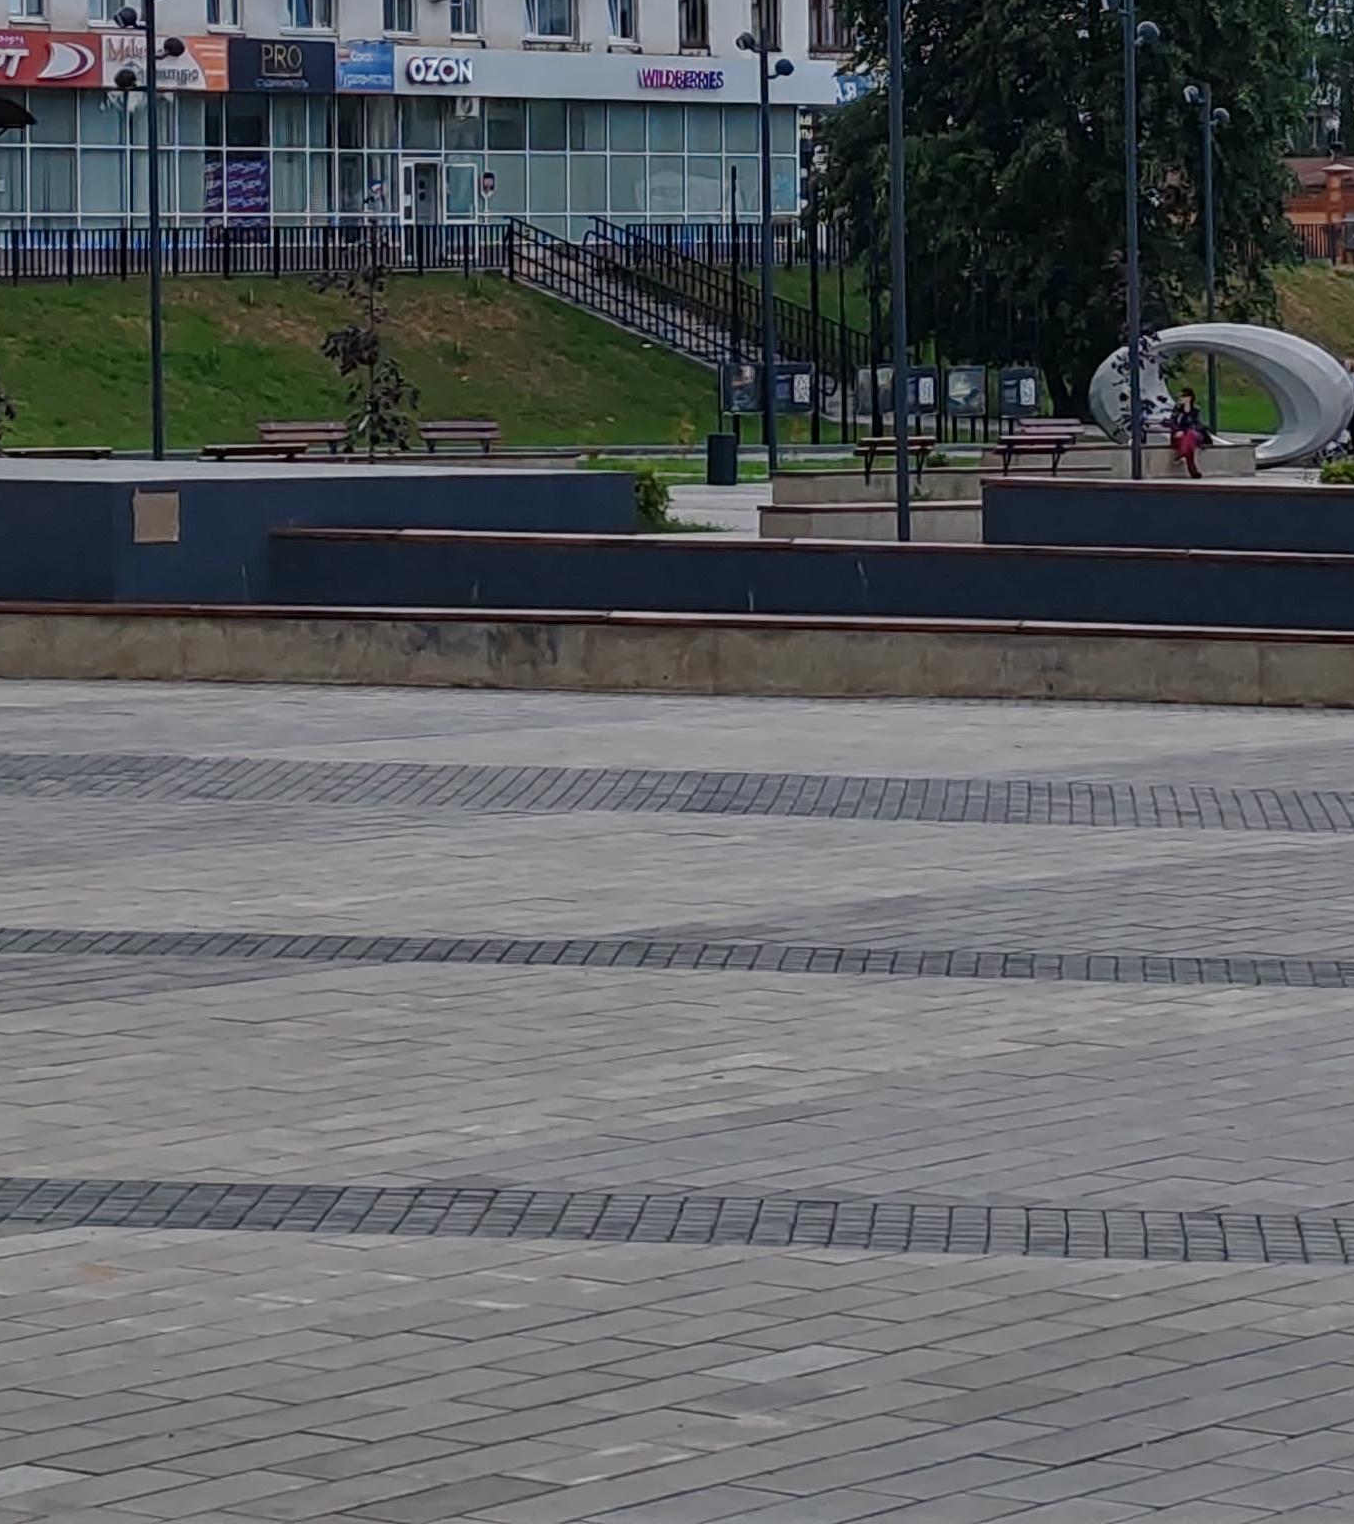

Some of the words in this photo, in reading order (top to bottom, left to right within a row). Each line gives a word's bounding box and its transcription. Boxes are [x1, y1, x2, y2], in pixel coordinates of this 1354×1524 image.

[261, 44, 302, 69] PRO
[407, 57, 473, 83] OZON
[637, 69, 724, 89] WILDBERRIES
